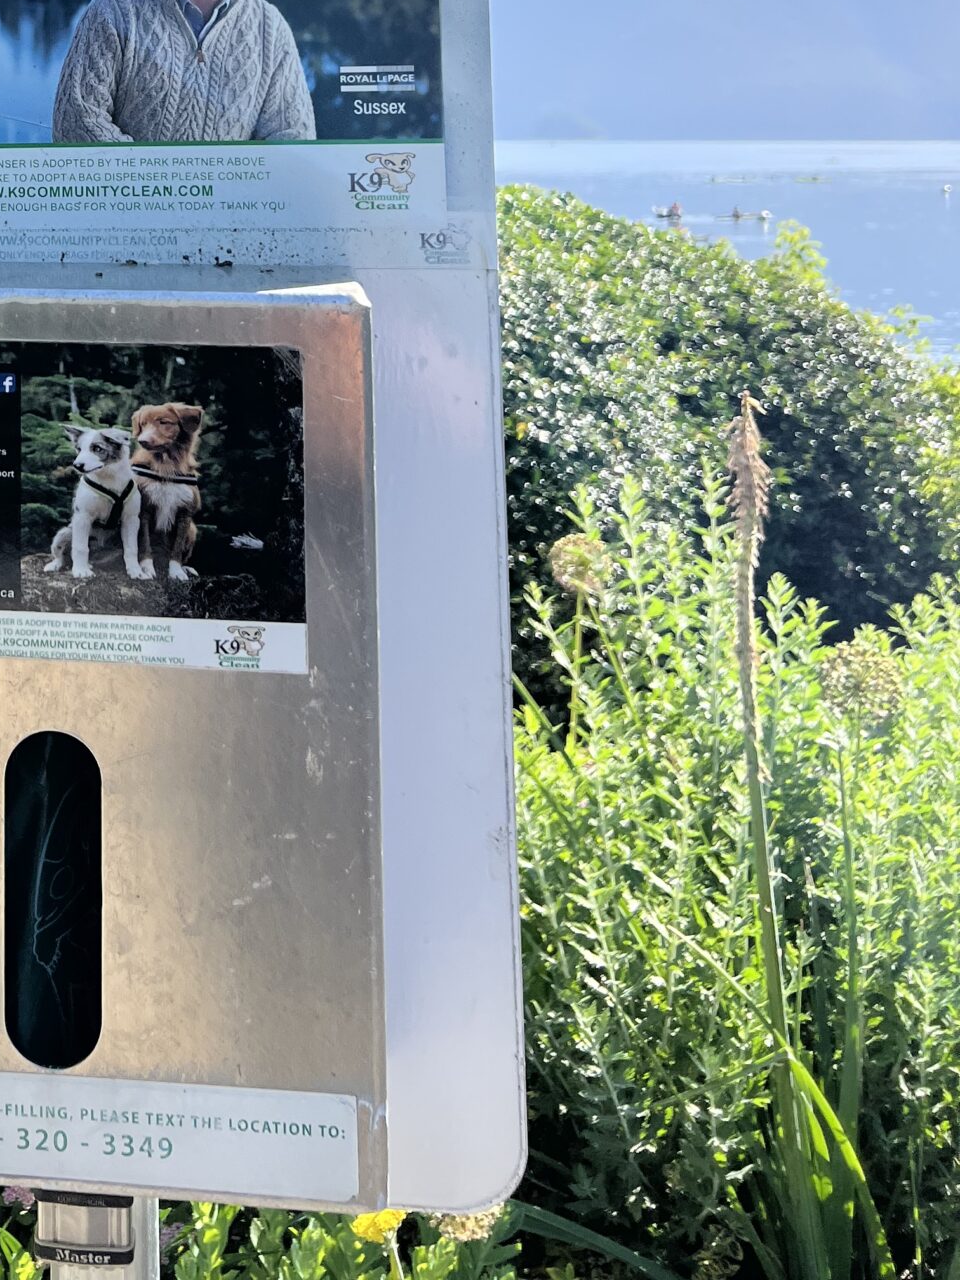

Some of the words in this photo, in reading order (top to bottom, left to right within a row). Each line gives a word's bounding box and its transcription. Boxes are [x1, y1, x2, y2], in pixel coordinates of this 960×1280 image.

[340, 74, 376, 83] ROYAL
[353, 99, 407, 115] Sussex
[29, 159, 39, 168] IS
[42, 158, 95, 168] ADOPTED
[98, 158, 112, 168] BY
[115, 158, 136, 167] THE
[140, 157, 169, 167] PARK
[172, 156, 224, 167] PARTNER
[226, 156, 265, 166] ABOVE
[13, 173, 28, 182] TO
[29, 173, 67, 183] ADOPT
[69, 173, 77, 182] A
[79, 172, 102, 182] BAG
[104, 172, 168, 182] DISPENSER
[171, 171, 214, 181] PLEASE
[218, 171, 271, 181] CONTACT
[347, 171, 383, 193] K9
[354, 192, 410, 203] Community
[355, 200, 409, 210] Clean
[214, 638, 240, 655] K9
[80, 1108, 140, 1125] PLEASE
[145, 1112, 185, 1128] TEXT
[190, 1115, 223, 1131] THE
[228, 1118, 313, 1137] LOCATION
[318, 1124, 346, 1140] TO:
[17, 1126, 69, 1153] 320
[102, 1132, 174, 1160] 3349
[55, 1248, 111, 1264] Master
